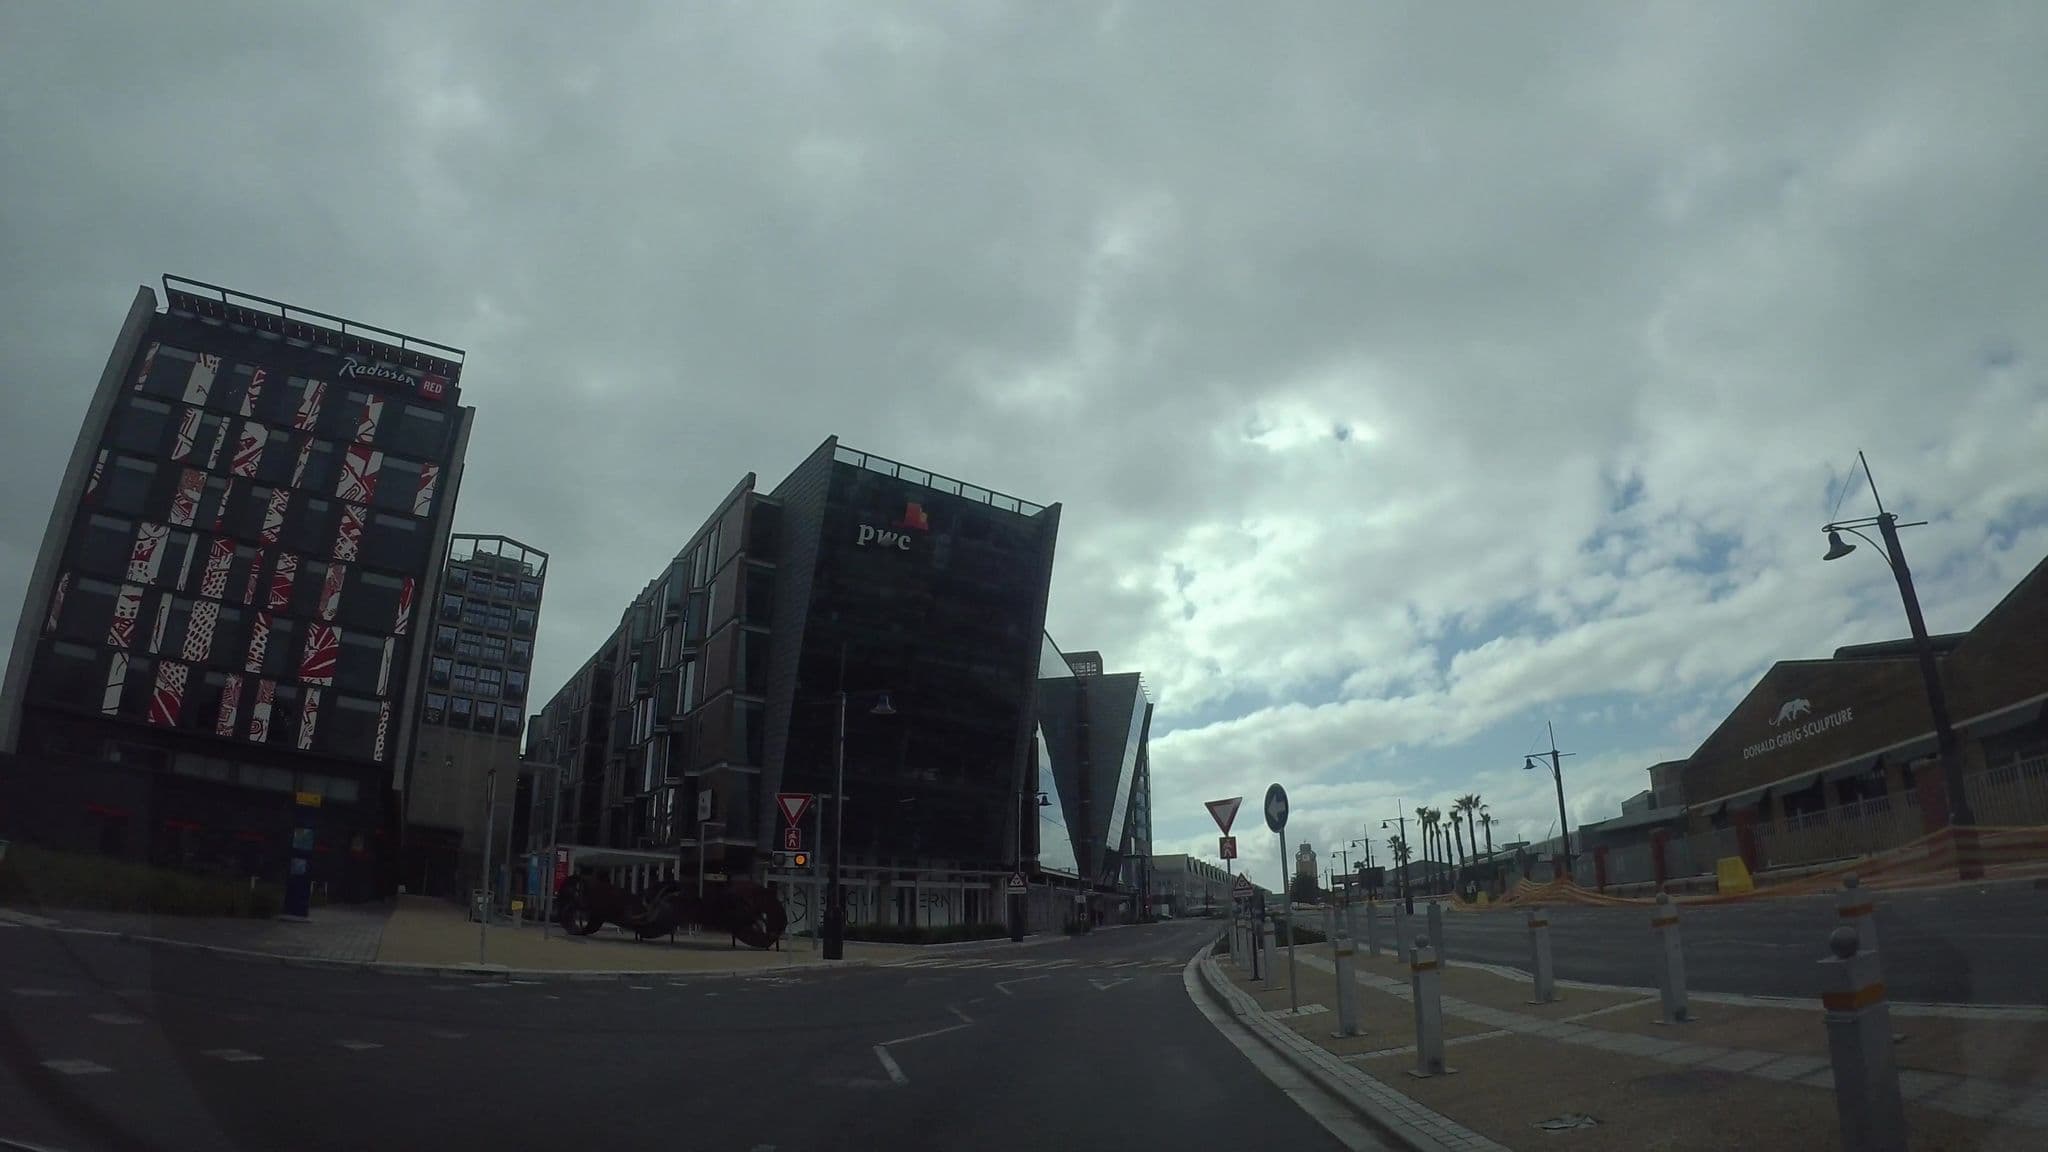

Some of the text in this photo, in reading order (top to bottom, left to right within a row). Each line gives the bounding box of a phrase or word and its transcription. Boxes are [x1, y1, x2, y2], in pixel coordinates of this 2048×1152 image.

[338, 356, 443, 395] Radisson RED
[856, 523, 912, 551] pwc
[1743, 707, 1854, 760] DONALD GREIG SCULPTURE
